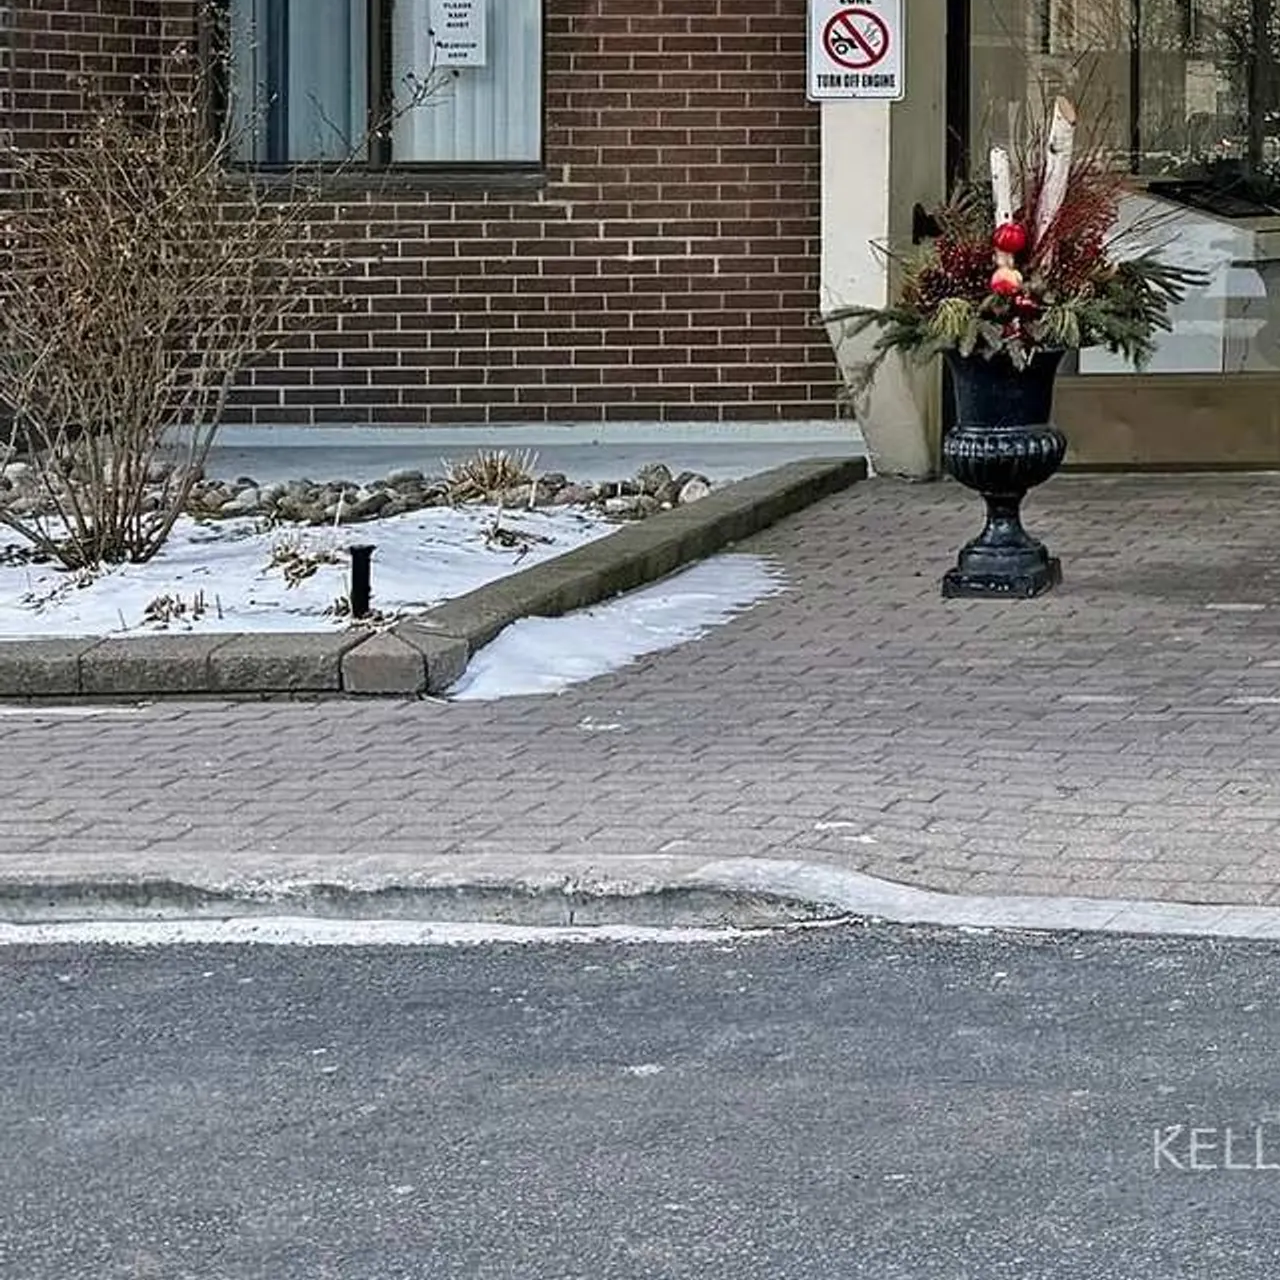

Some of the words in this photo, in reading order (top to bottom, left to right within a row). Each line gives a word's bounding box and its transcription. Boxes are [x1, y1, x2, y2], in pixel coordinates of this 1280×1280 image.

[817, 73, 841, 88] TURN
[843, 73, 860, 88] OFF
[861, 74, 896, 89] ENGINE
